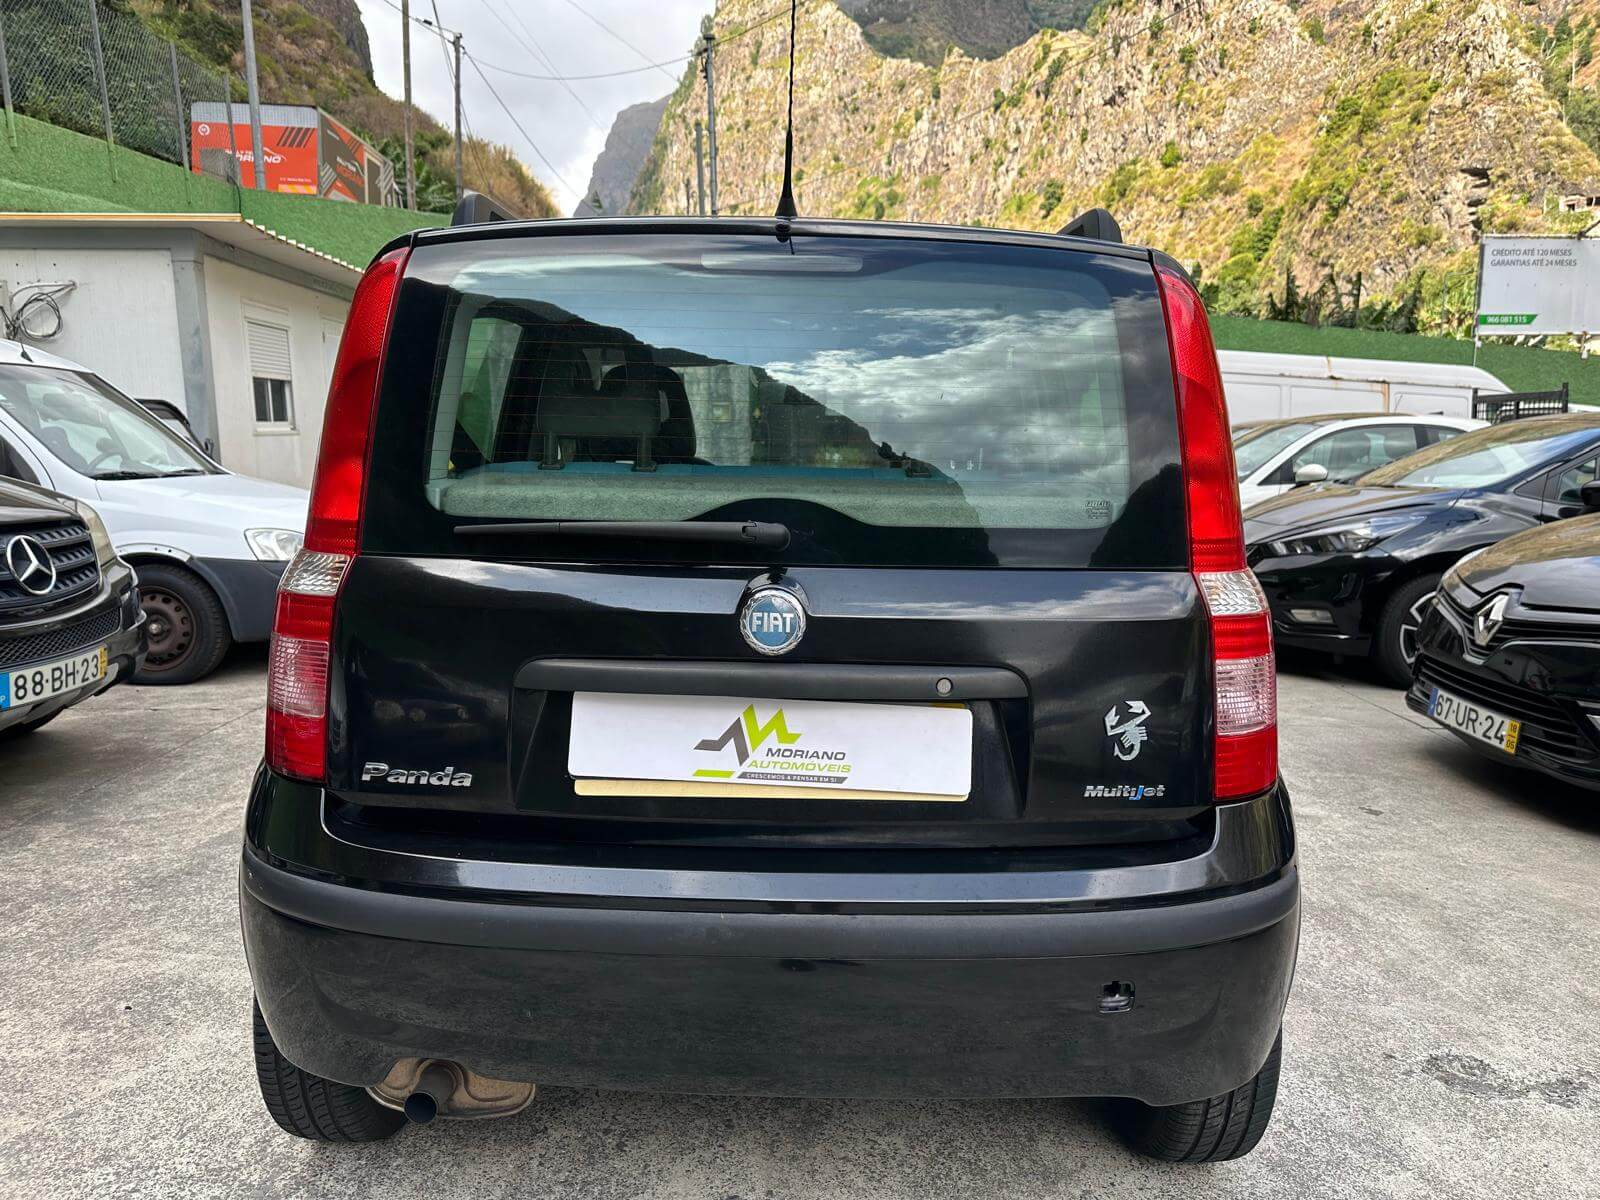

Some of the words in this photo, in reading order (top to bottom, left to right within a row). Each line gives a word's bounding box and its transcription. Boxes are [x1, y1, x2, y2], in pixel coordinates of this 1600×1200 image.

[1491, 248, 1521, 257] CRÉDITO
[1522, 247, 1535, 256] ATÉ
[1536, 248, 1549, 256] 120
[1549, 248, 1572, 257] MESES
[1490, 259, 1531, 267] GARANTIAS
[1531, 258, 1544, 267] ATÉ
[1545, 259, 1554, 267] 24
[1554, 259, 1577, 267] MESES
[752, 612, 794, 632] FIAT
[766, 748, 846, 761] MORIANO
[748, 760, 852, 773] AUTOMÓVEIS
[360, 761, 473, 787] Panda
[745, 773, 786, 781] CRESCEMOS
[792, 775, 818, 783] PENSAR
